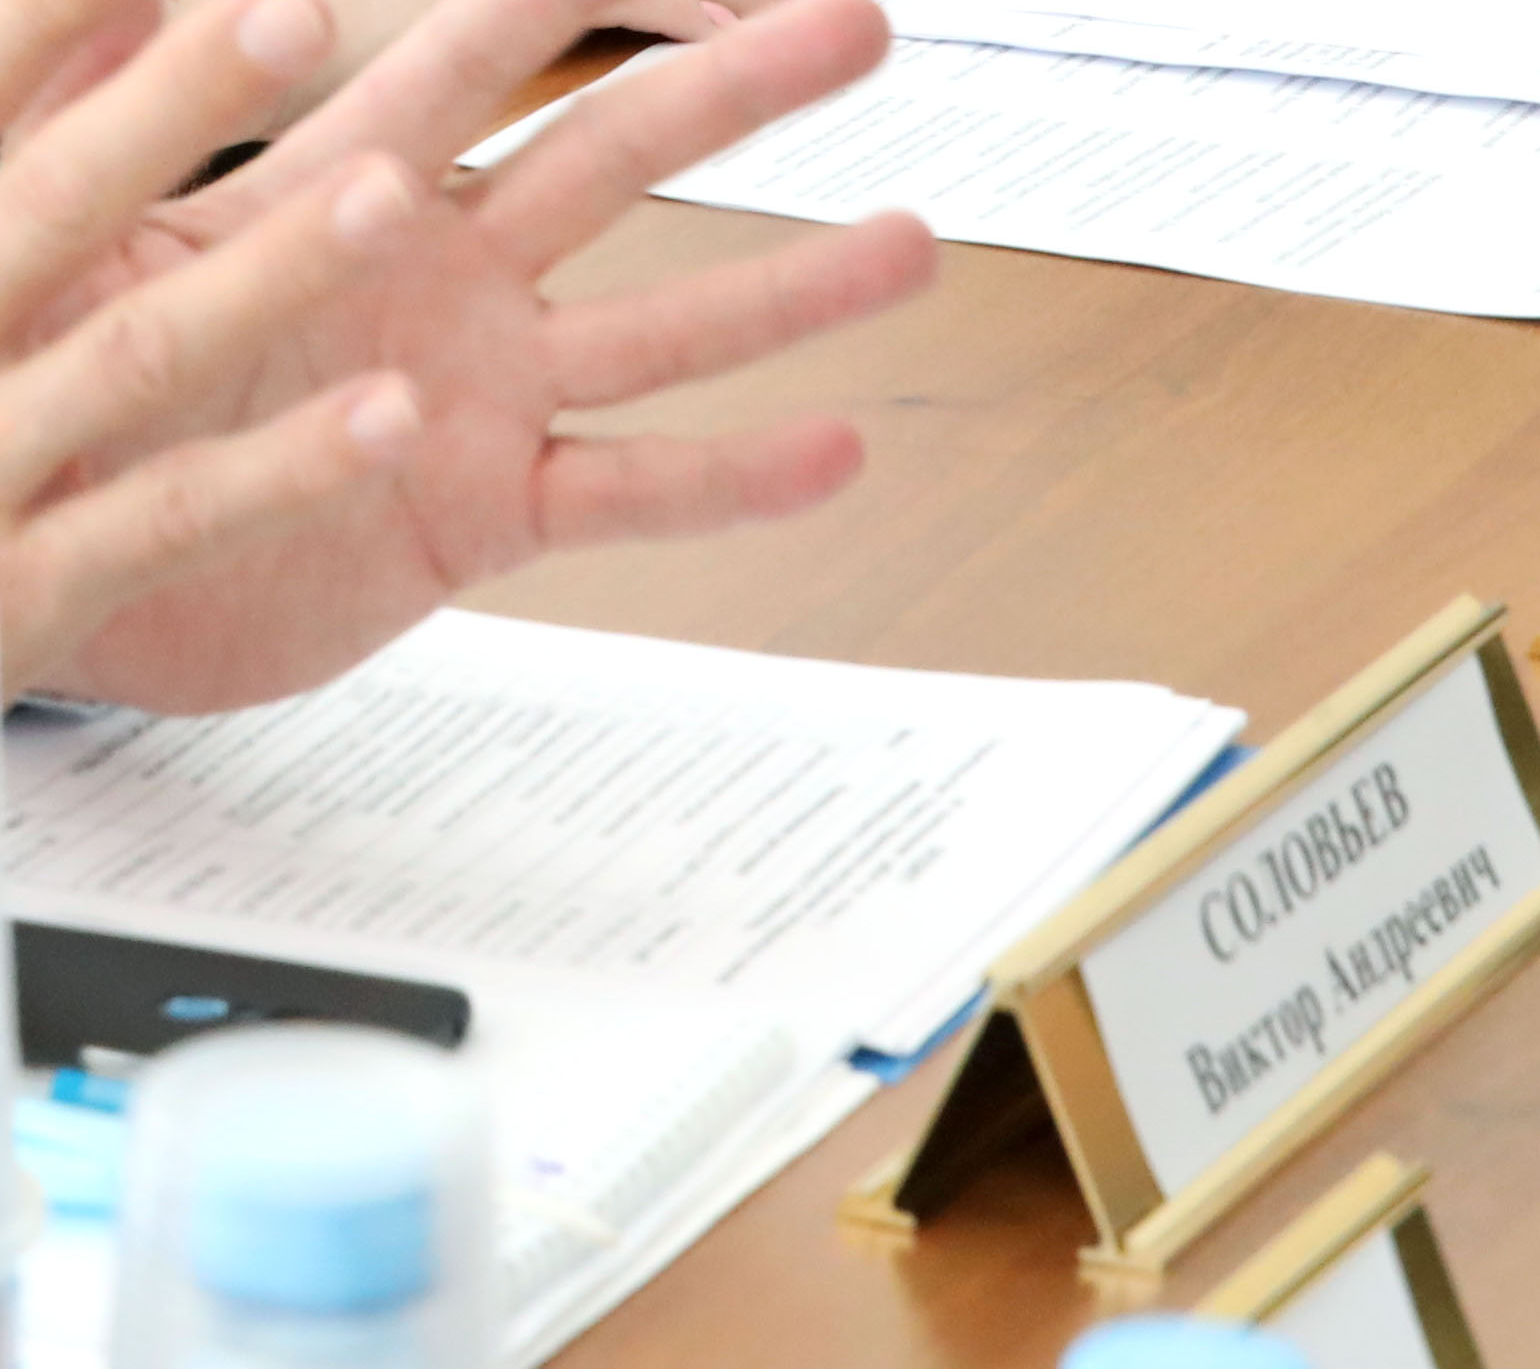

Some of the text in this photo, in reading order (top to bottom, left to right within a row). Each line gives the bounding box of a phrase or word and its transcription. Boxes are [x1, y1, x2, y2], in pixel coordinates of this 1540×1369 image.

[1185, 842, 1502, 1116] Виктор Андреевич
[1198, 760, 1411, 965] СОЛОВЬЕВ
